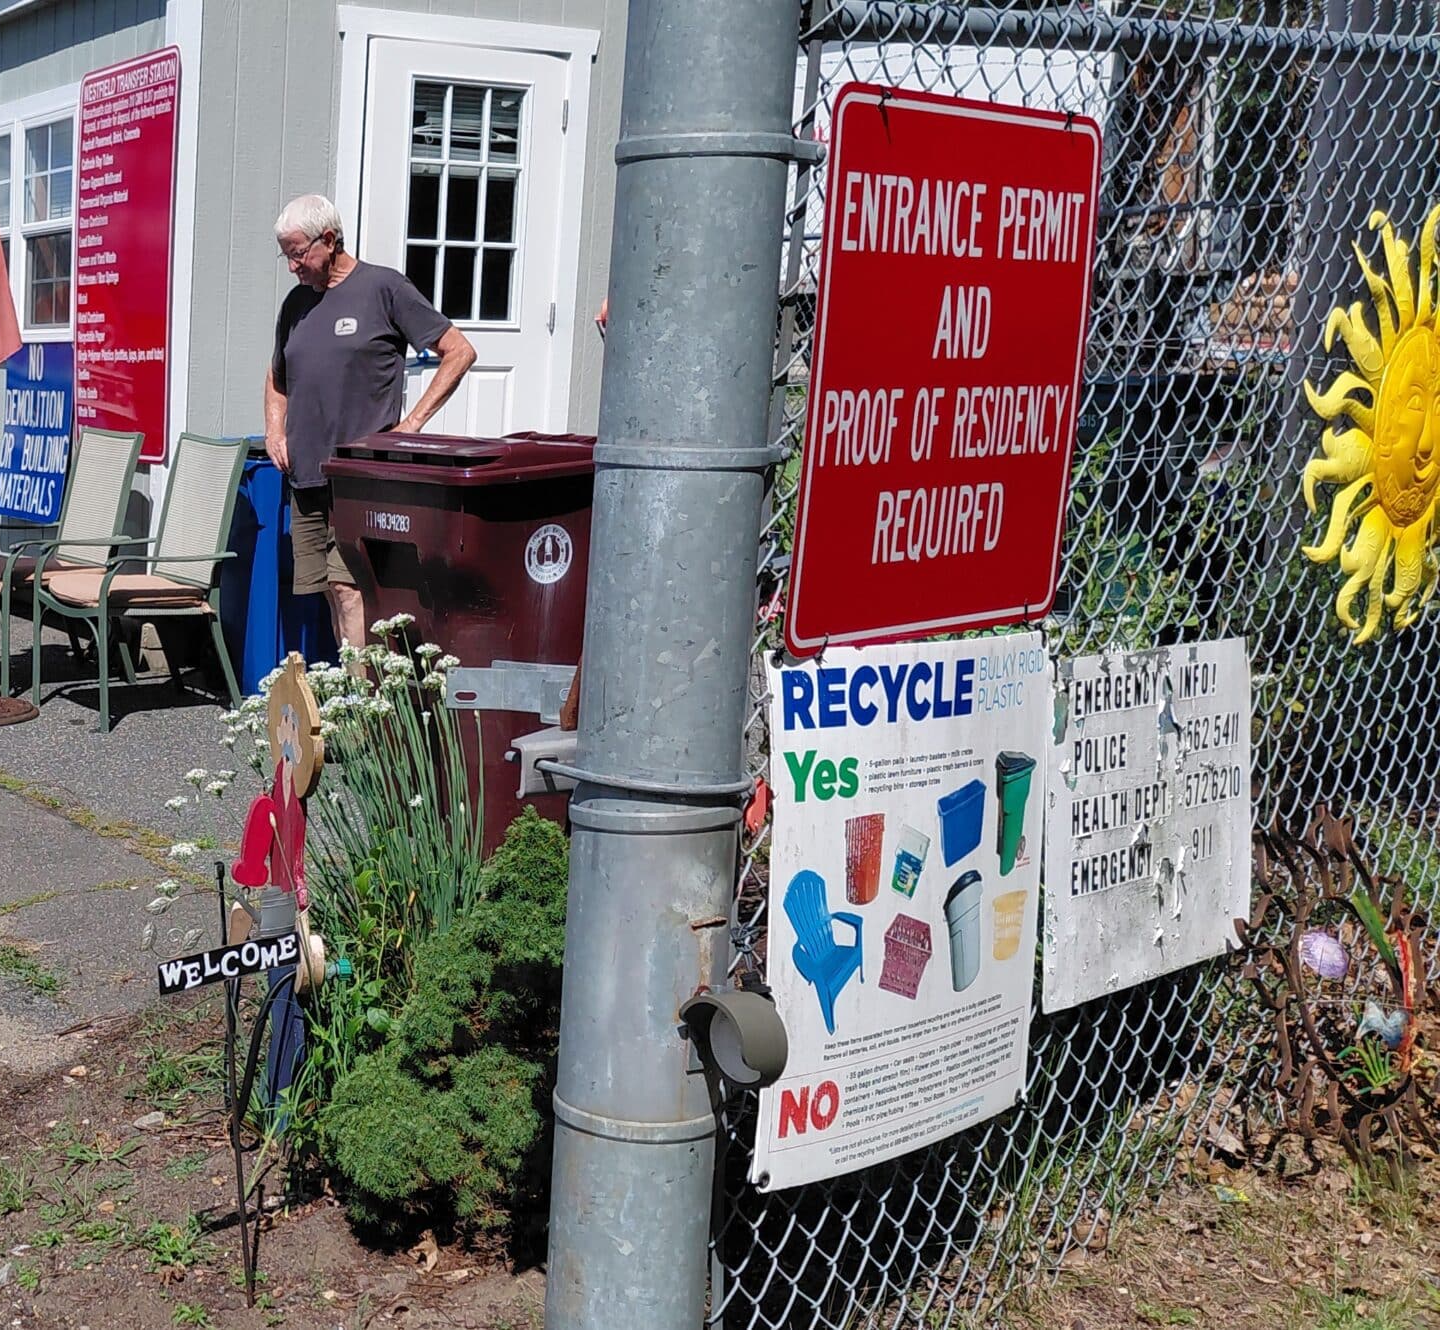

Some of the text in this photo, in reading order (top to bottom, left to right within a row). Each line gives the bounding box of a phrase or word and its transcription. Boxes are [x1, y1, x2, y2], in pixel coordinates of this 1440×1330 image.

[149, 57, 176, 83] STATION
[840, 171, 1085, 263] ENTRANCE PERMIT
[932, 285, 992, 360] AND
[28, 344, 44, 381] NO
[4, 389, 65, 430] DEMOLITION
[819, 385, 1069, 468] PROOF OF RESIDENCY
[0, 432, 70, 475] OR BUILDING
[780, 648, 1044, 731] RECYCLE BULKY RIGID
[977, 682, 1024, 713] PLASTIC
[1074, 662, 1217, 717] EMERGENCY INFO!
[1074, 711, 1240, 774] POLICE 562 5411
[783, 750, 859, 803] Yes
[1072, 791, 1128, 837] HEALTH
[1185, 771, 1209, 808] 572
[1211, 766, 1241, 802] 6210
[1071, 824, 1212, 898] EMERGENCY 911
[159, 934, 297, 990] WELCOME
[778, 1080, 840, 1139] NO
